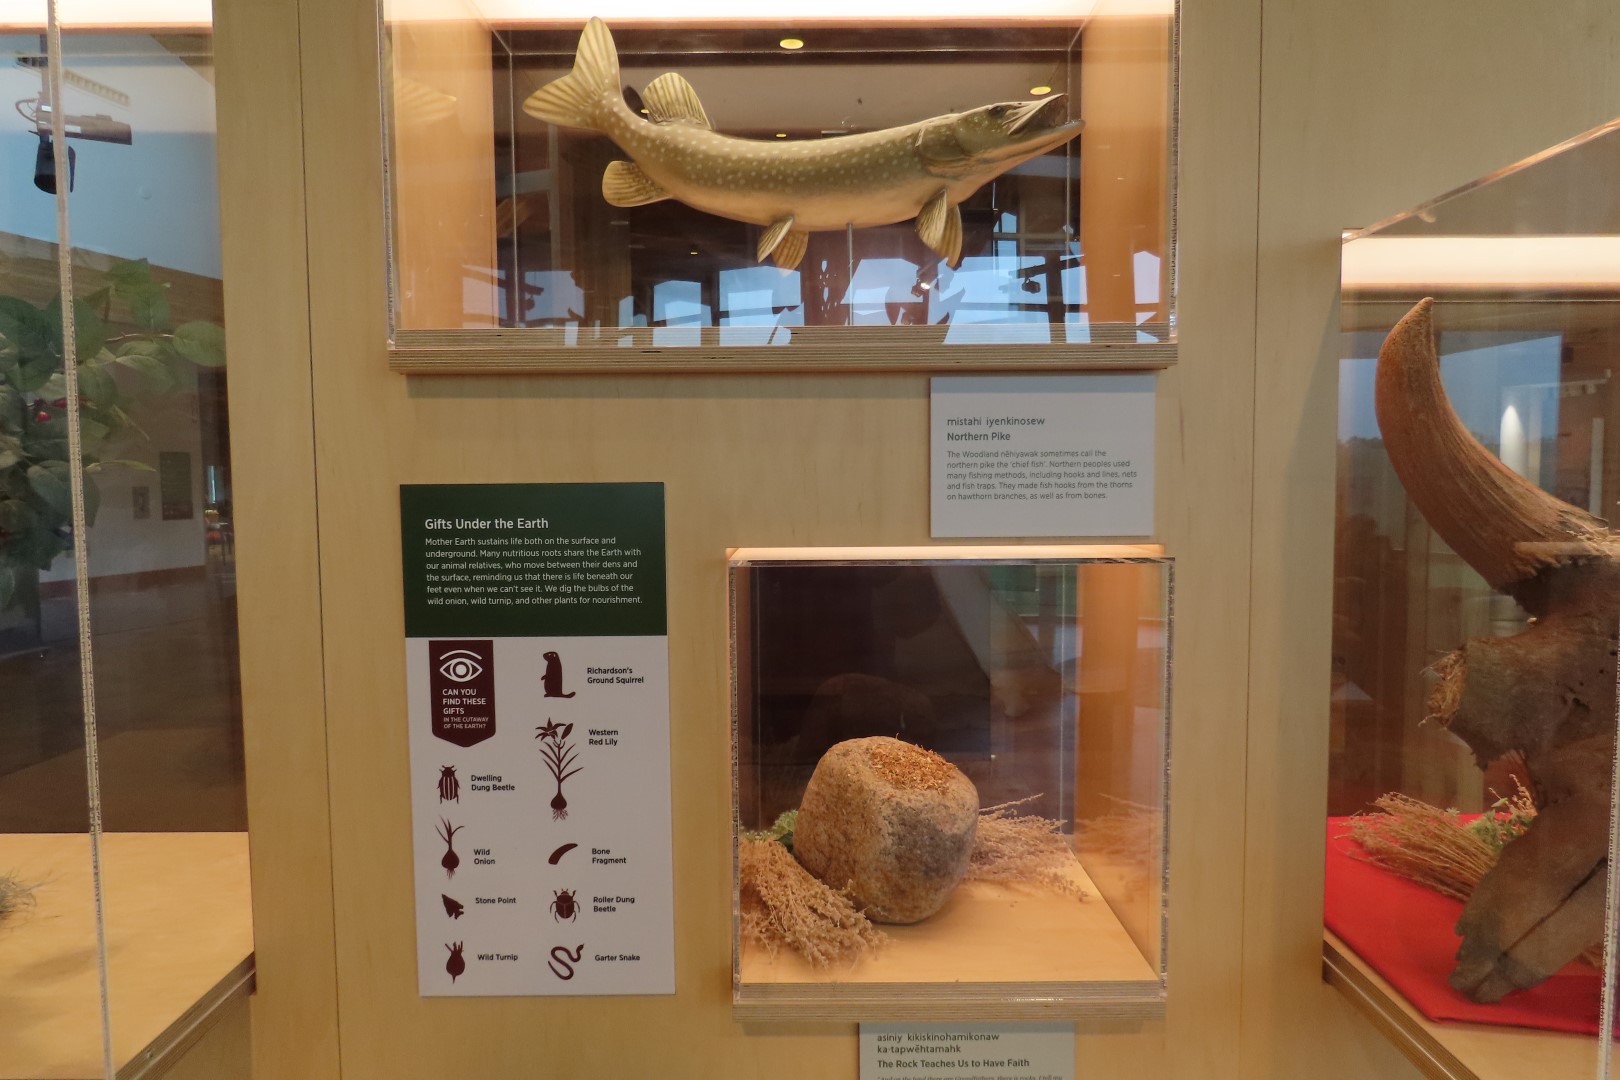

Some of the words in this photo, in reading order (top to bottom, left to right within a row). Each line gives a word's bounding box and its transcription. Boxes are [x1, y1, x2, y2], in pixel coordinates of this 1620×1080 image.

[947, 417, 982, 426] mistahi
[986, 416, 1046, 428] iyenkinosew
[947, 432, 989, 441] Northern
[991, 432, 1011, 441] Pike
[947, 450, 961, 459] The
[968, 471, 993, 480] fishing
[1029, 471, 1063, 480] including
[999, 482, 1016, 491] They
[425, 518, 453, 530] Gifts
[456, 518, 492, 530] Under
[495, 518, 514, 529] the
[517, 518, 549, 529] Earth
[454, 538, 476, 546] Earth
[478, 537, 509, 546] sustains
[571, 536, 600, 545] surface
[601, 536, 616, 545] and
[426, 550, 478, 559] underground.
[480, 550, 501, 559] Many
[564, 549, 585, 557] share
[586, 549, 600, 557] the
[601, 548, 623, 556] Earth
[441, 562, 467, 570] animal
[468, 562, 503, 570] relatives,
[582, 561, 601, 569] their
[426, 574, 440, 582] the
[441, 574, 472, 582] surface,
[473, 573, 513, 582] reminding
[542, 572, 563, 581] there
[572, 572, 585, 581] life
[586, 572, 619, 580] beneath
[427, 586, 442, 594] feet
[544, 585, 558, 593] We
[559, 584, 572, 594] dig
[611, 584, 620, 592] of
[488, 598, 514, 606] turnip,
[515, 596, 530, 605] and
[554, 596, 578, 605] plants
[592, 596, 643, 604] nourishment.
[616, 676, 644, 685] Squirrel
[605, 738, 618, 747] Lily
[470, 774, 502, 783] Dwelling
[471, 784, 491, 792] Dung
[592, 857, 627, 865] Fragment
[616, 896, 636, 904] Dung
[496, 954, 519, 962] Turnip
[877, 1032, 903, 1044] asiniy
[878, 1060, 894, 1068] The
[896, 1060, 918, 1068] Rock
[920, 1059, 956, 1068] Teaches
[958, 1059, 969, 1068] Us
[983, 1059, 1005, 1068] Have
[1007, 1058, 1030, 1067] Faith
